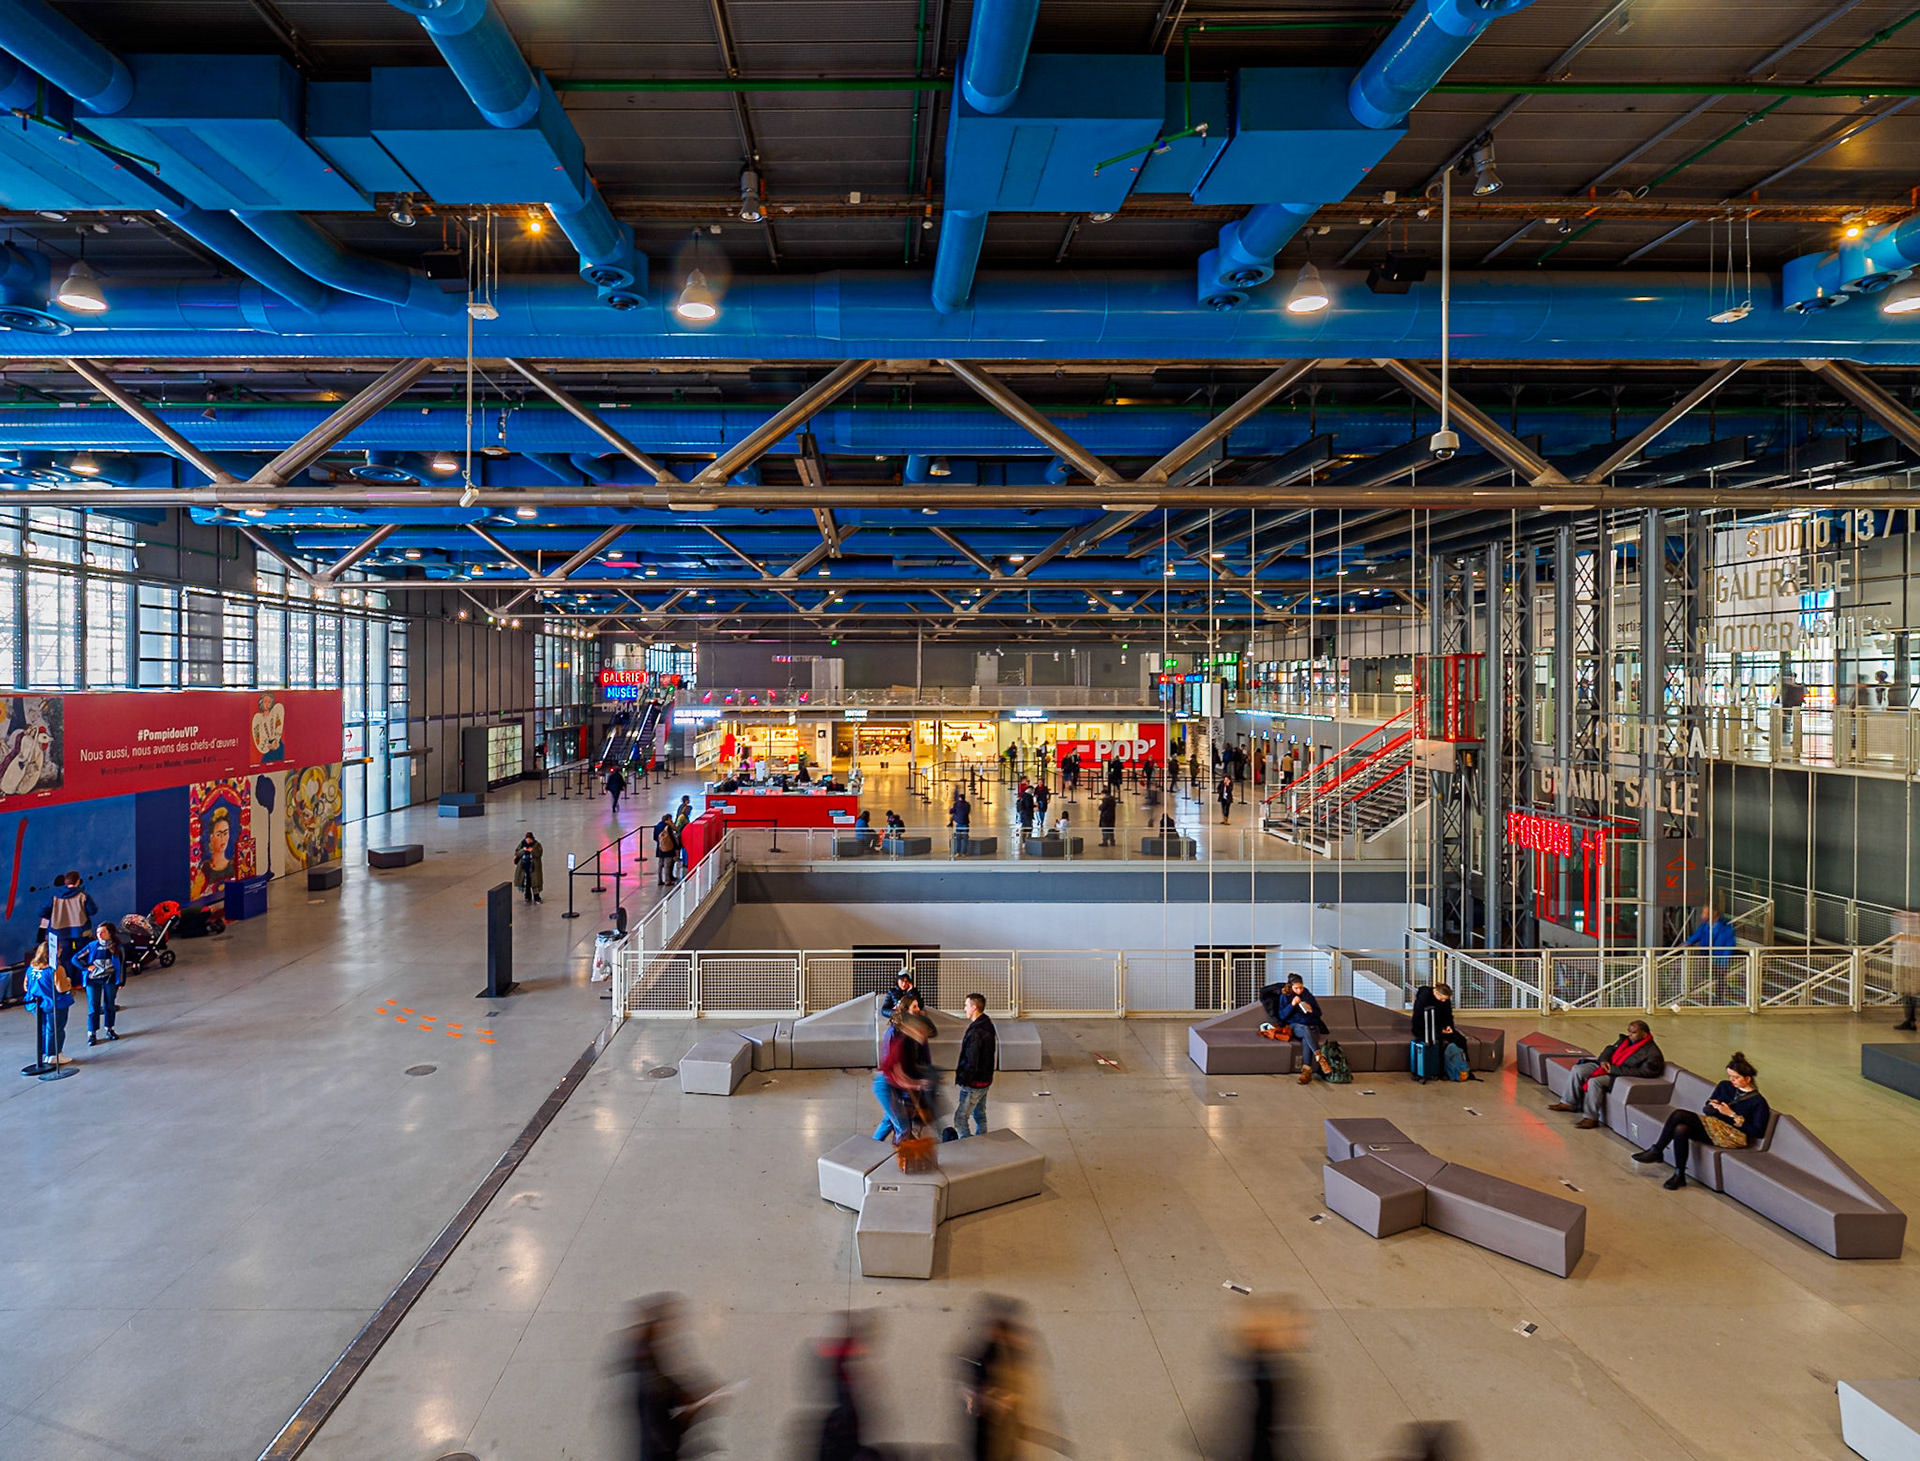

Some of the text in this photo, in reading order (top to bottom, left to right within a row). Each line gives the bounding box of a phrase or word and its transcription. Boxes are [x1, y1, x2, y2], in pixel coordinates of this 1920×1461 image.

[1746, 515, 1831, 557] STUDIO
[1841, 509, 1875, 543] 13
[1716, 559, 1851, 603] GALERE DE
[1696, 615, 1893, 654] PHOTOGRAPHIES
[603, 672, 647, 683] GALERIE 1
[607, 685, 638, 699] MUSÉE
[80, 749, 104, 762] Nous
[105, 746, 130, 760] aussi,
[132, 746, 151, 757] nous
[153, 743, 175, 754] avons
[176, 741, 189, 752] des
[137, 726, 199, 742] #PompidouVIP
[1595, 721, 1755, 763] PETITE SALLE
[1540, 766, 1699, 817] GRANDE SALLE
[1508, 812, 1606, 865] FORUM -1
